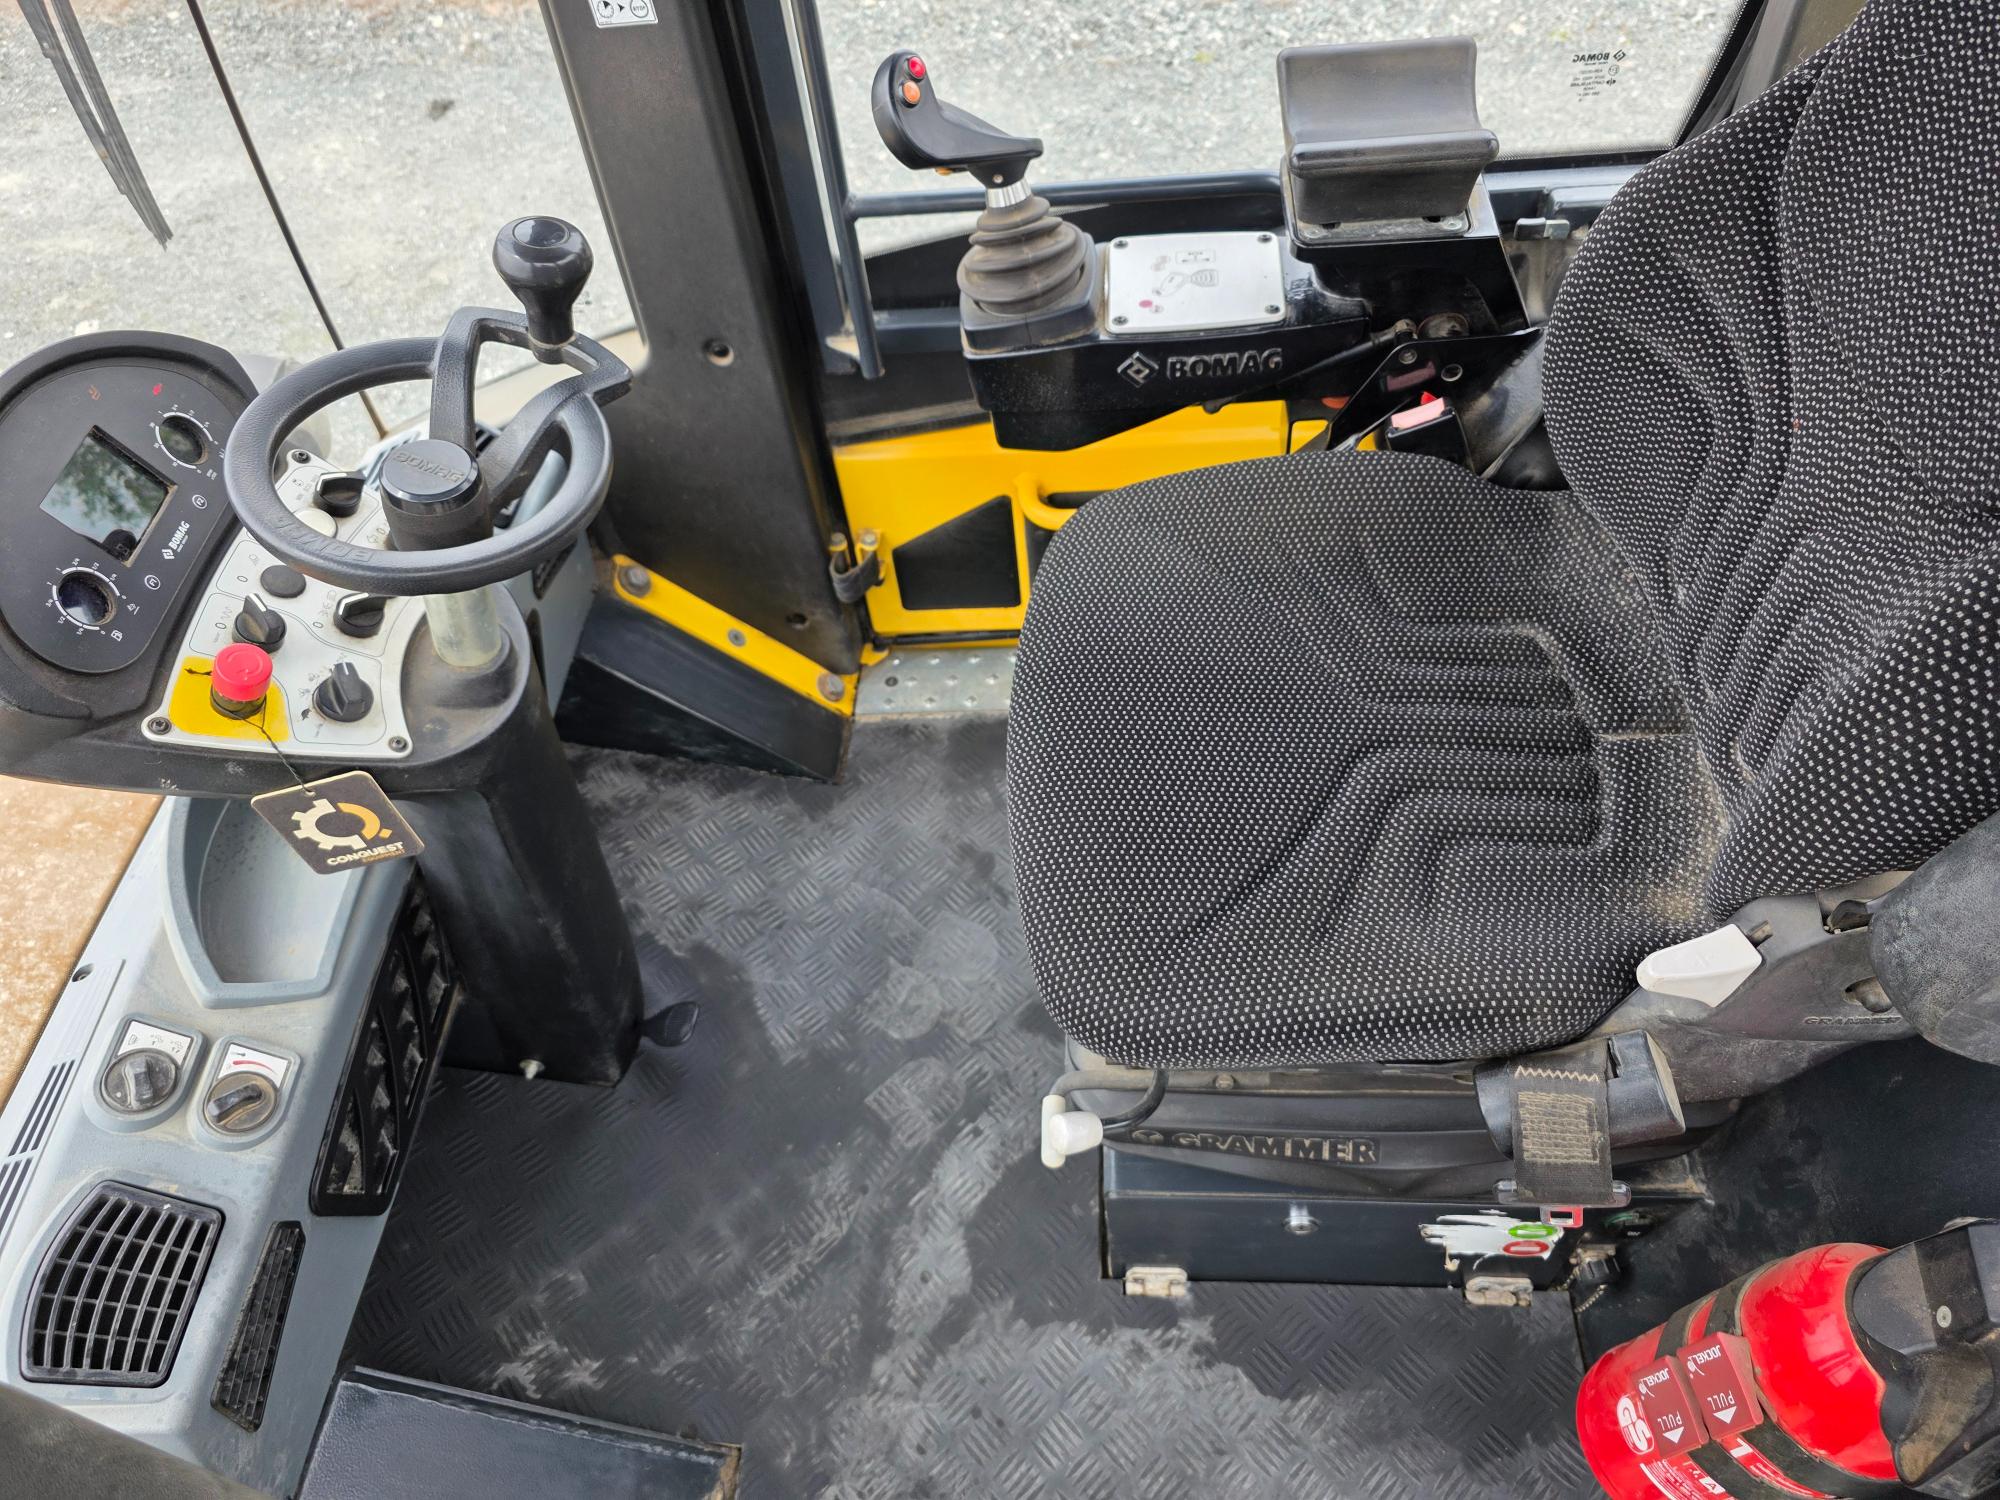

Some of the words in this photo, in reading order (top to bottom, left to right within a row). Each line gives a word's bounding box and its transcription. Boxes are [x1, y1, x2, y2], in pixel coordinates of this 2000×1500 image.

[1166, 348, 1282, 379] BOMAG
[394, 451, 465, 483] BOMAG
[168, 520, 190, 550] BOMAG
[312, 621, 324, 629] 0
[326, 841, 403, 866] CONQUEST
[1802, 1015, 1902, 1025] GRAMMER
[1172, 1131, 1377, 1164] GRAMMER
[1694, 1344, 1721, 1365] JOCKEL
[1643, 1367, 1670, 1387] JOCKEL
[1706, 1389, 1736, 1411] PULL
[1657, 1410, 1683, 1431] PULL
